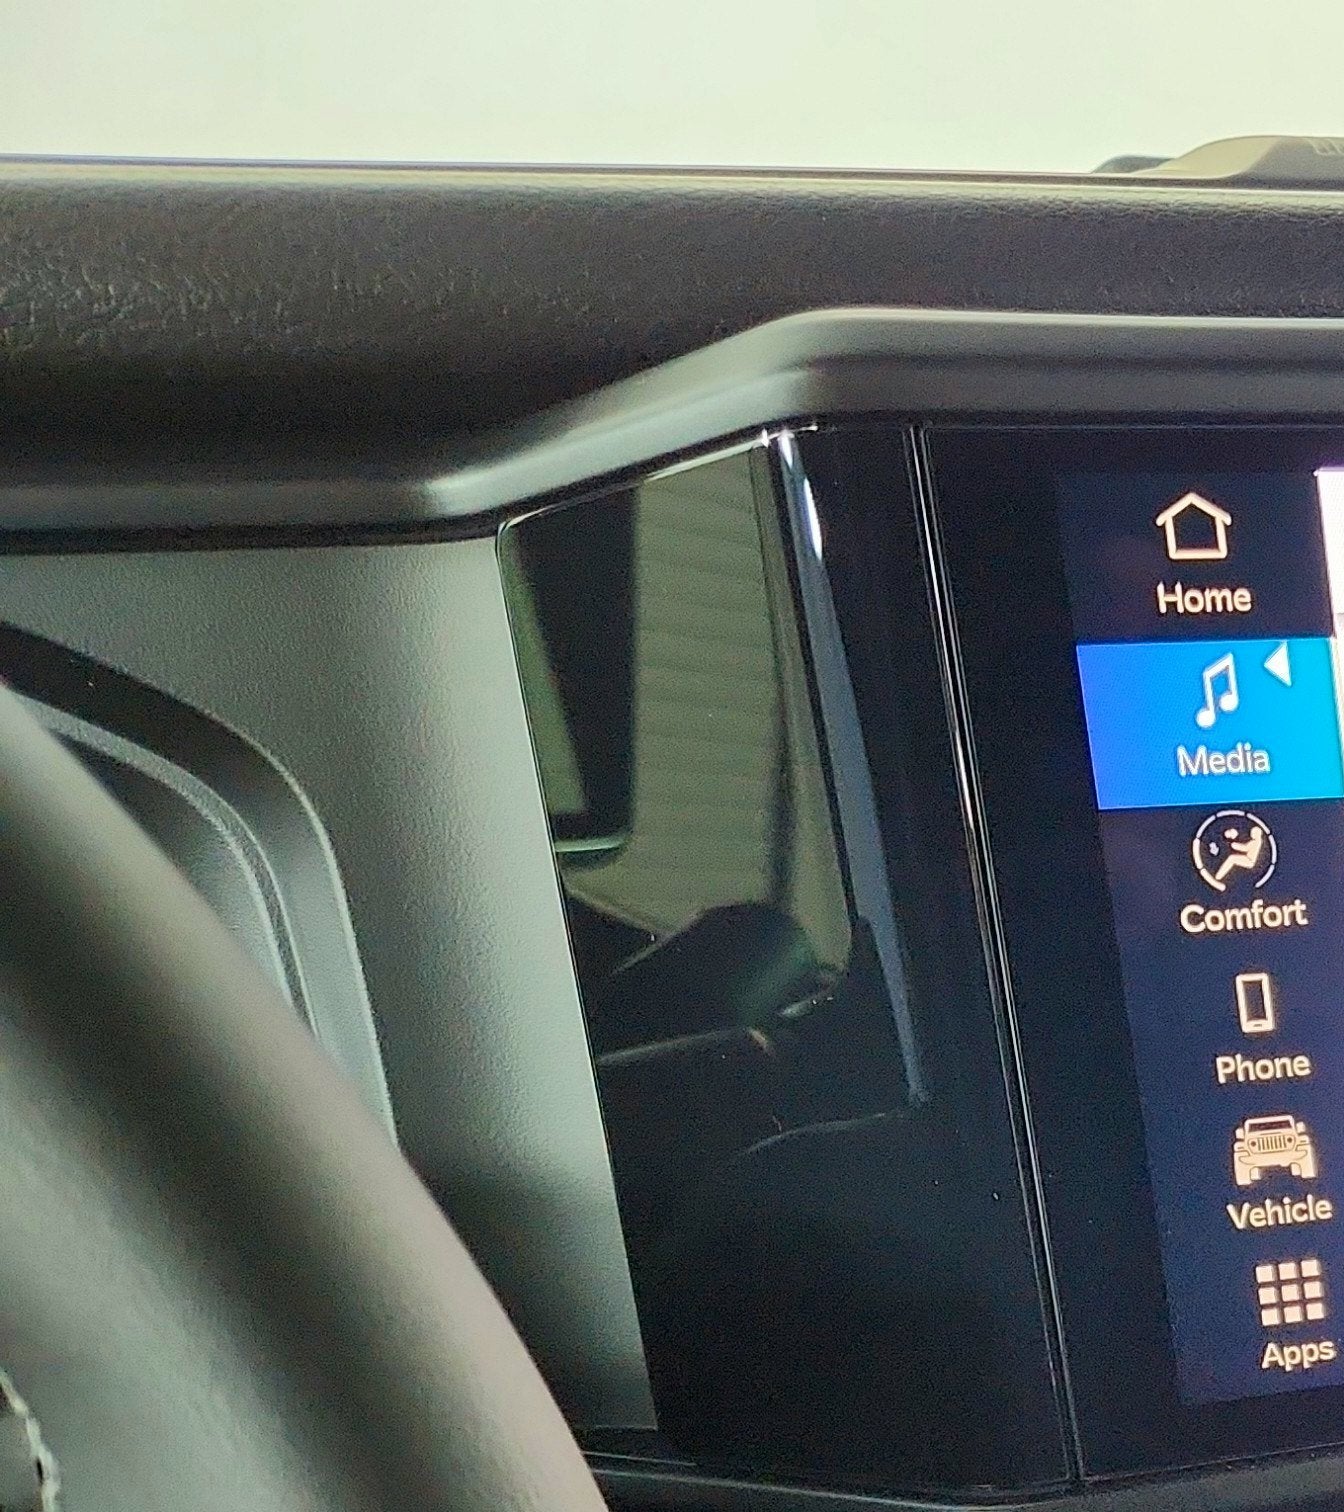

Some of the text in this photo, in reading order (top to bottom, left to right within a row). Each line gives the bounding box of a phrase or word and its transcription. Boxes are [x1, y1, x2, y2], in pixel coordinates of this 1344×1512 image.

[1156, 582, 1252, 614] Home
[1177, 743, 1271, 776] Media
[1179, 898, 1309, 934] Comfort
[1215, 1051, 1311, 1085] Phone
[1226, 1196, 1333, 1231] Vehicle
[1260, 1340, 1337, 1373] Apps
